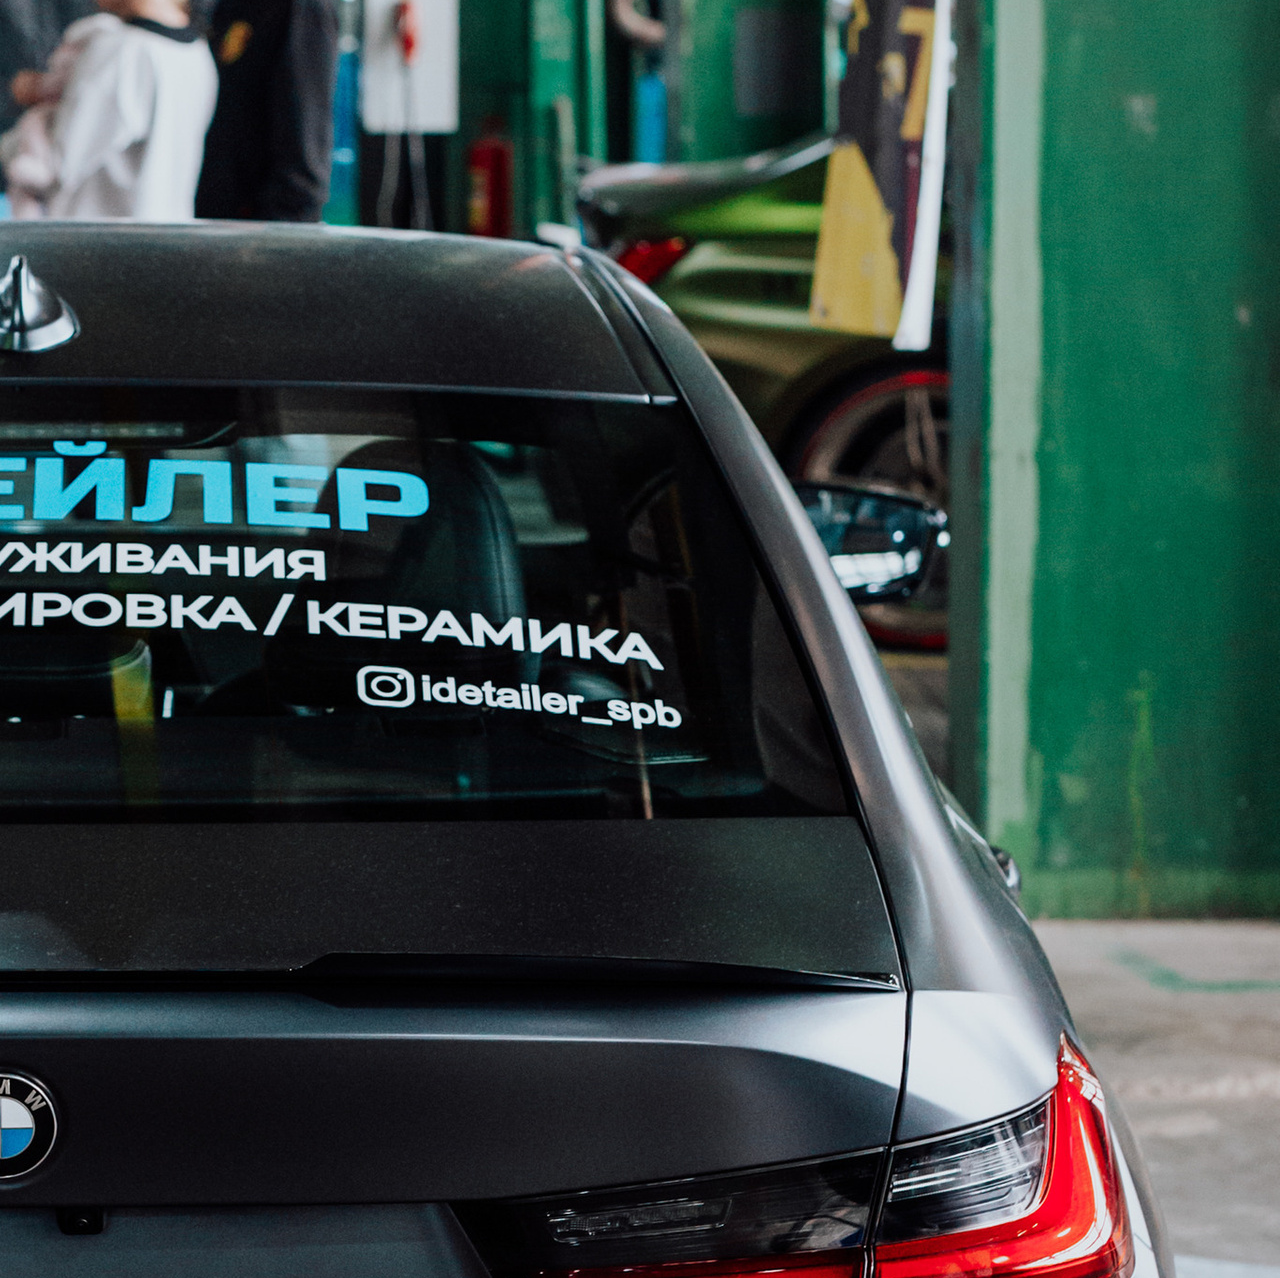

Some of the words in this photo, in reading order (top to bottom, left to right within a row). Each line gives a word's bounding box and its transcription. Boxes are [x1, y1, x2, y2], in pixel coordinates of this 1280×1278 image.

[263, 593, 295, 636] /
[307, 599, 665, 671] КЕРАМИКА
[421, 674, 683, 730] idetailer_spb
